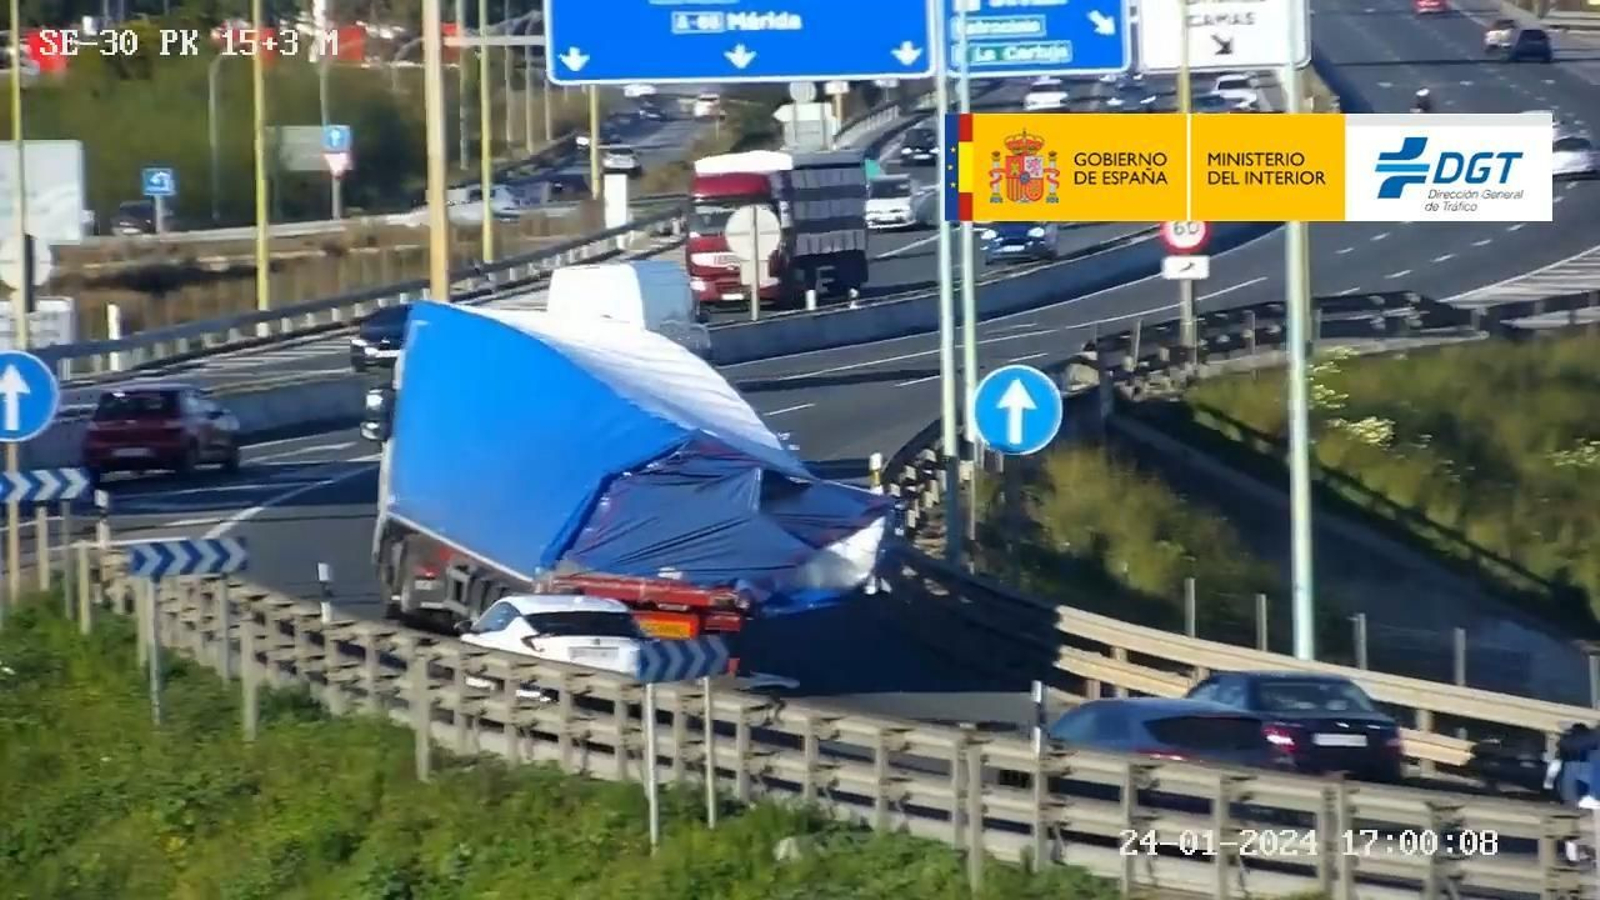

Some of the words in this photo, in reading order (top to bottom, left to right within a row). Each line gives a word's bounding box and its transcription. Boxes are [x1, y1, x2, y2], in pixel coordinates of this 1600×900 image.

[726, 11, 802, 31] Mérida
[976, 46, 997, 62] La
[1173, 220, 1200, 235] 60
